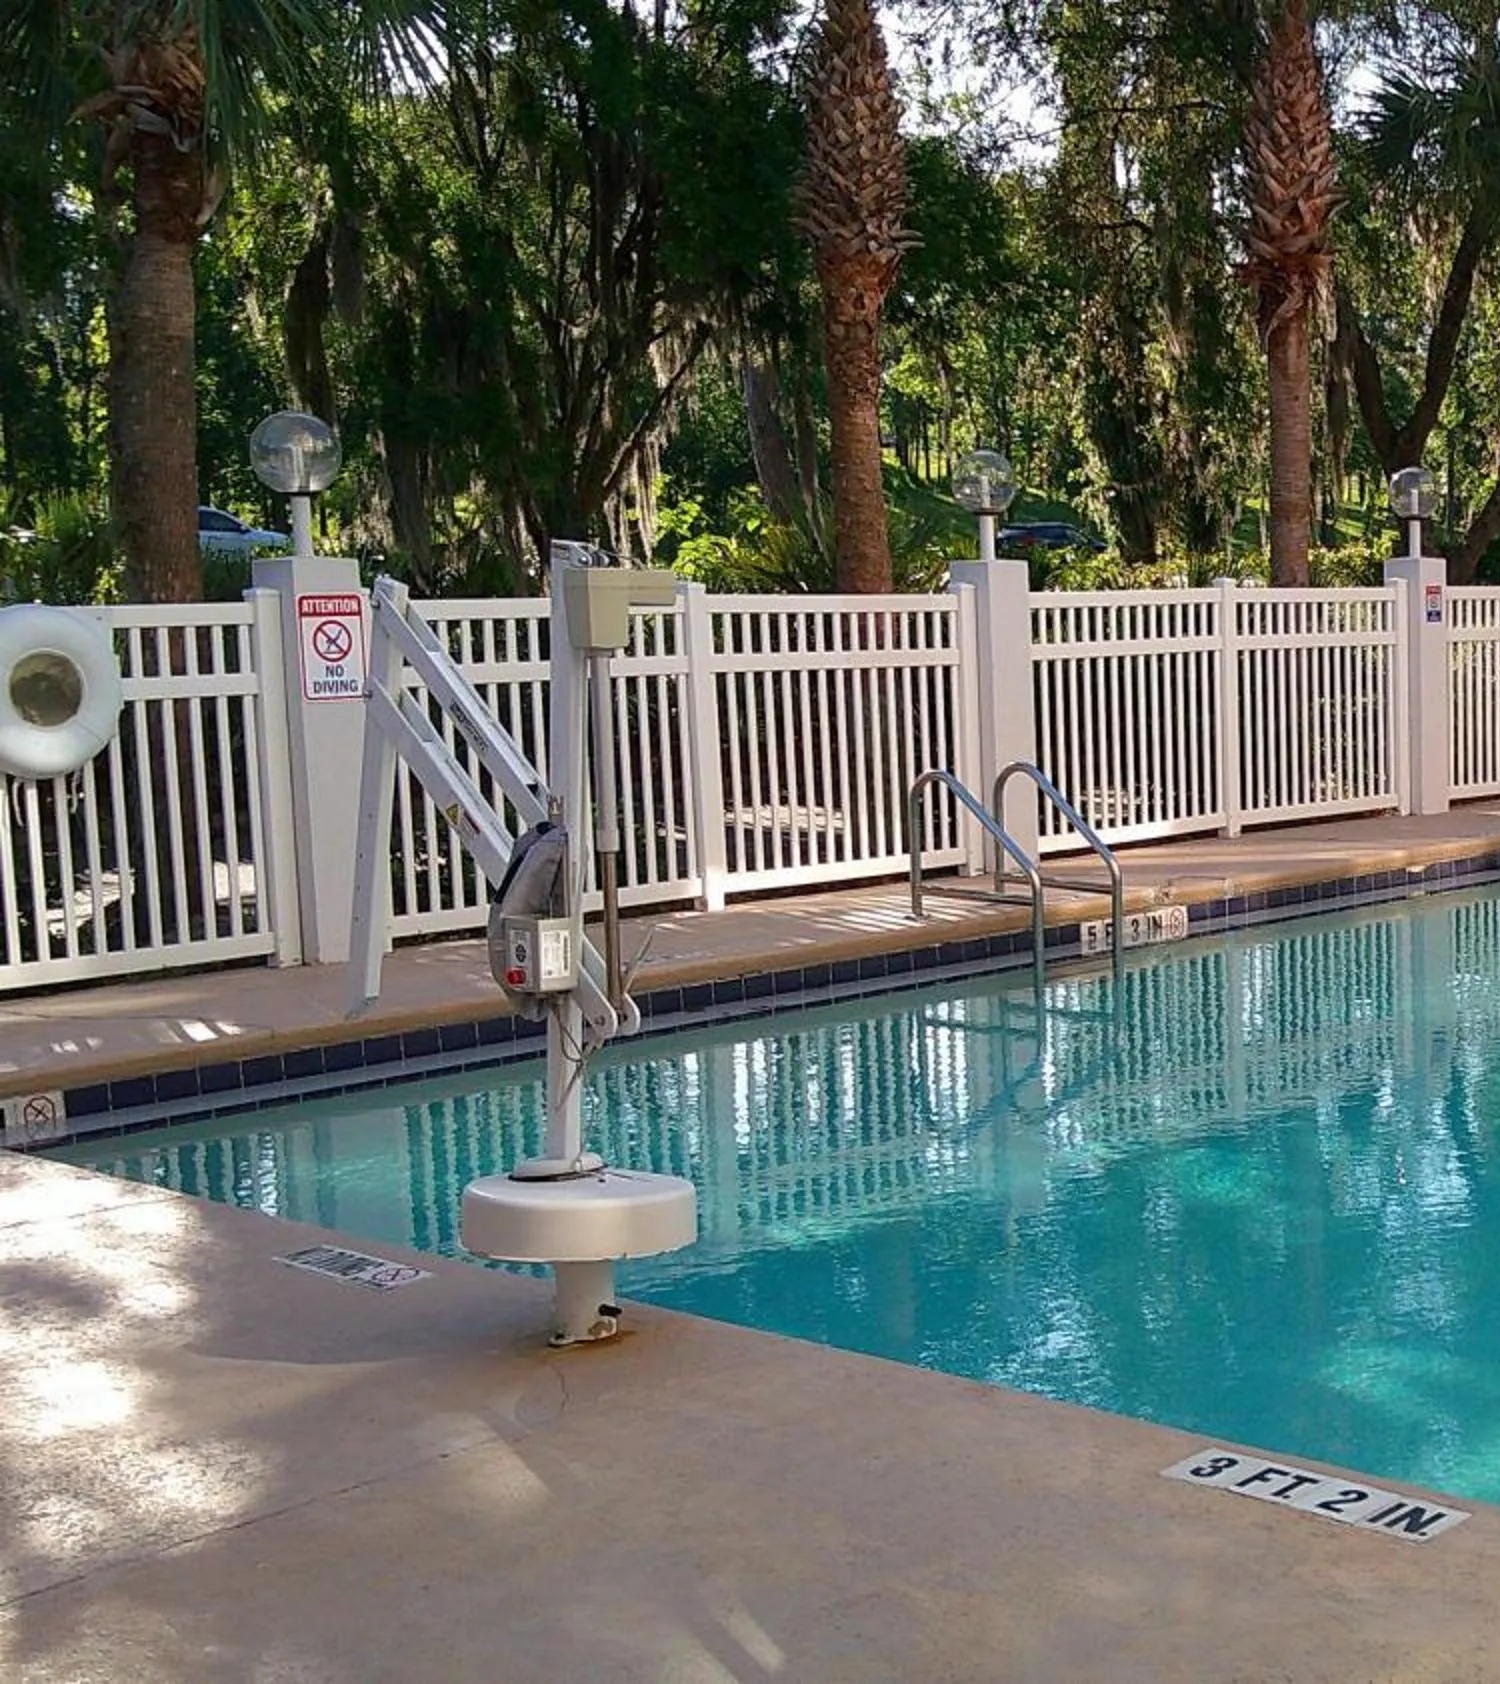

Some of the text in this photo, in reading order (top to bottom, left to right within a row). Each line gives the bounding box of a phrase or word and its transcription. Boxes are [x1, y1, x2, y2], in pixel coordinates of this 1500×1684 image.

[302, 598, 359, 613] ATTENTION
[325, 665, 345, 678] NO
[313, 680, 359, 694] DIVING
[1088, 925, 1097, 950] 5
[1131, 918, 1140, 942] 3
[1146, 913, 1163, 940] IN
[1190, 1456, 1239, 1478] 3
[1235, 1467, 1320, 1499] FT.
[1316, 1488, 1369, 1514] 2
